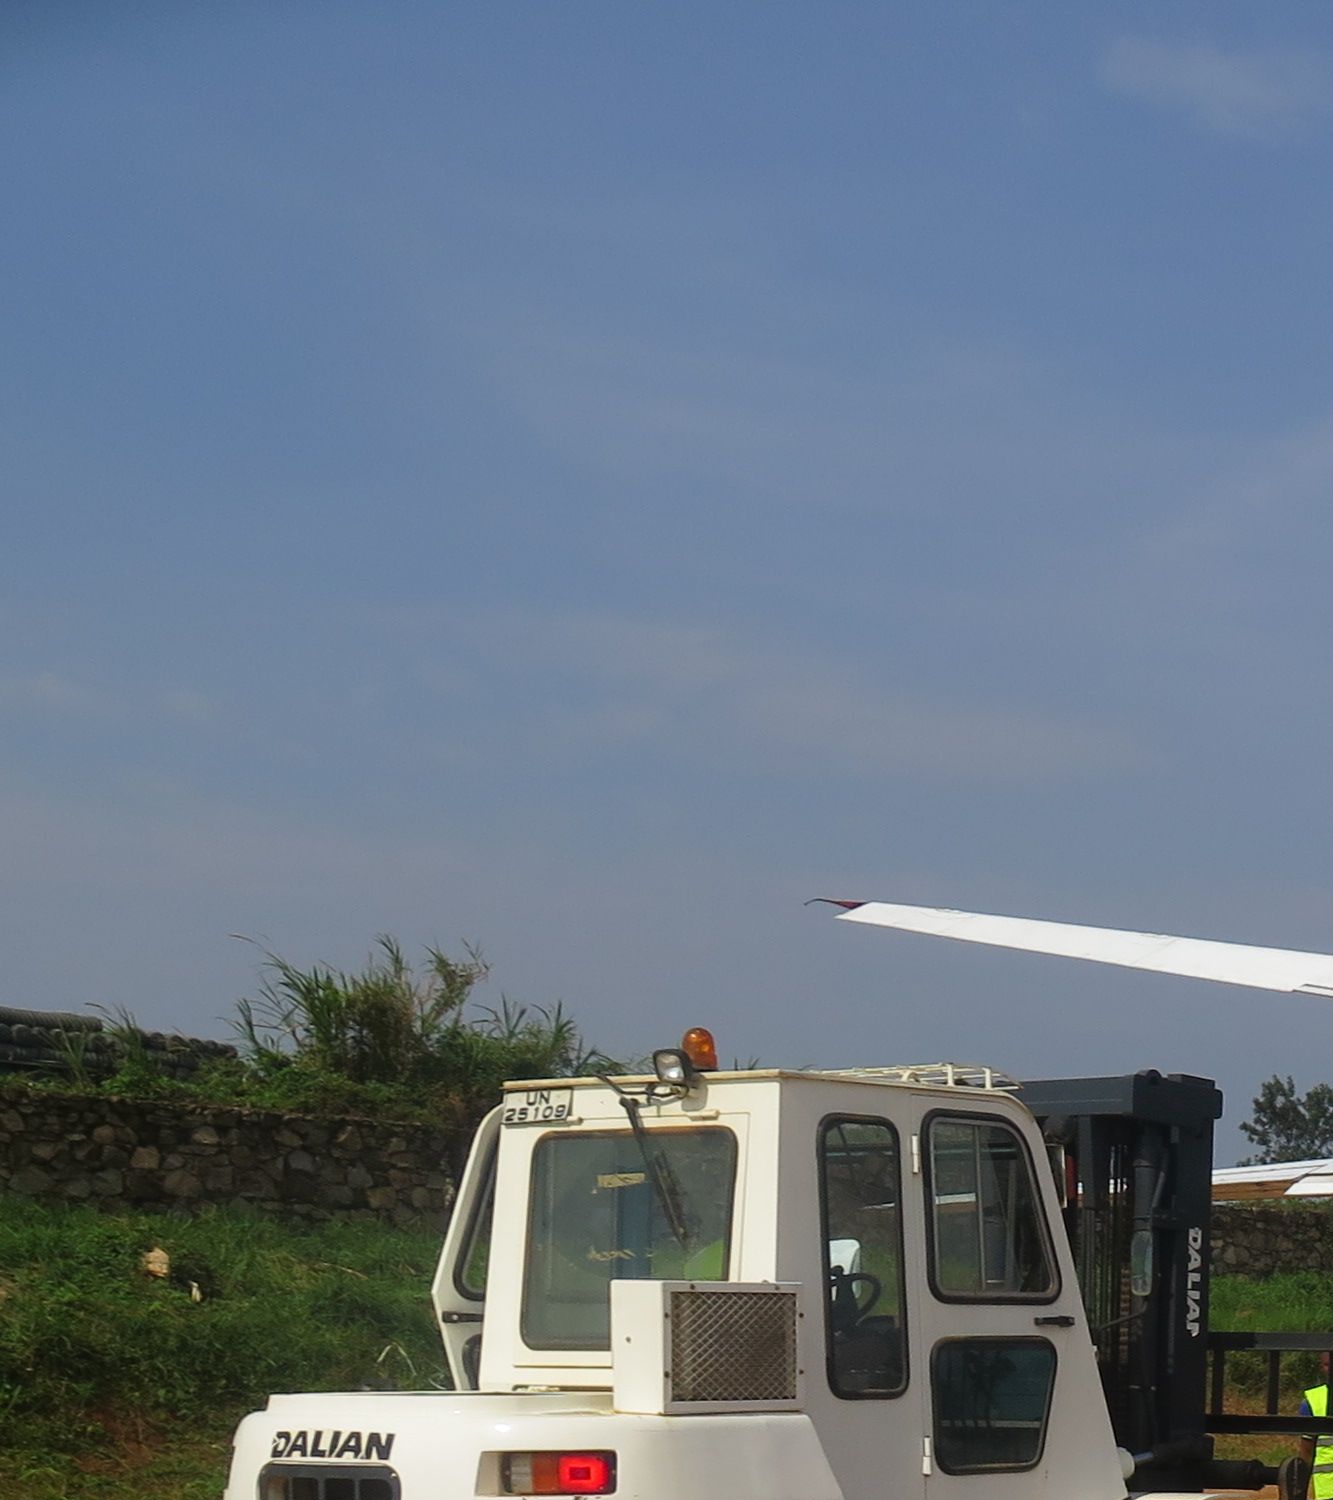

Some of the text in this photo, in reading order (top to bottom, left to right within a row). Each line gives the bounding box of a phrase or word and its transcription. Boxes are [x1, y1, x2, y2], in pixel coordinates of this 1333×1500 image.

[526, 1090, 551, 1106] UN
[504, 1104, 567, 1122] 25109
[270, 1430, 396, 1461] DALIAN
